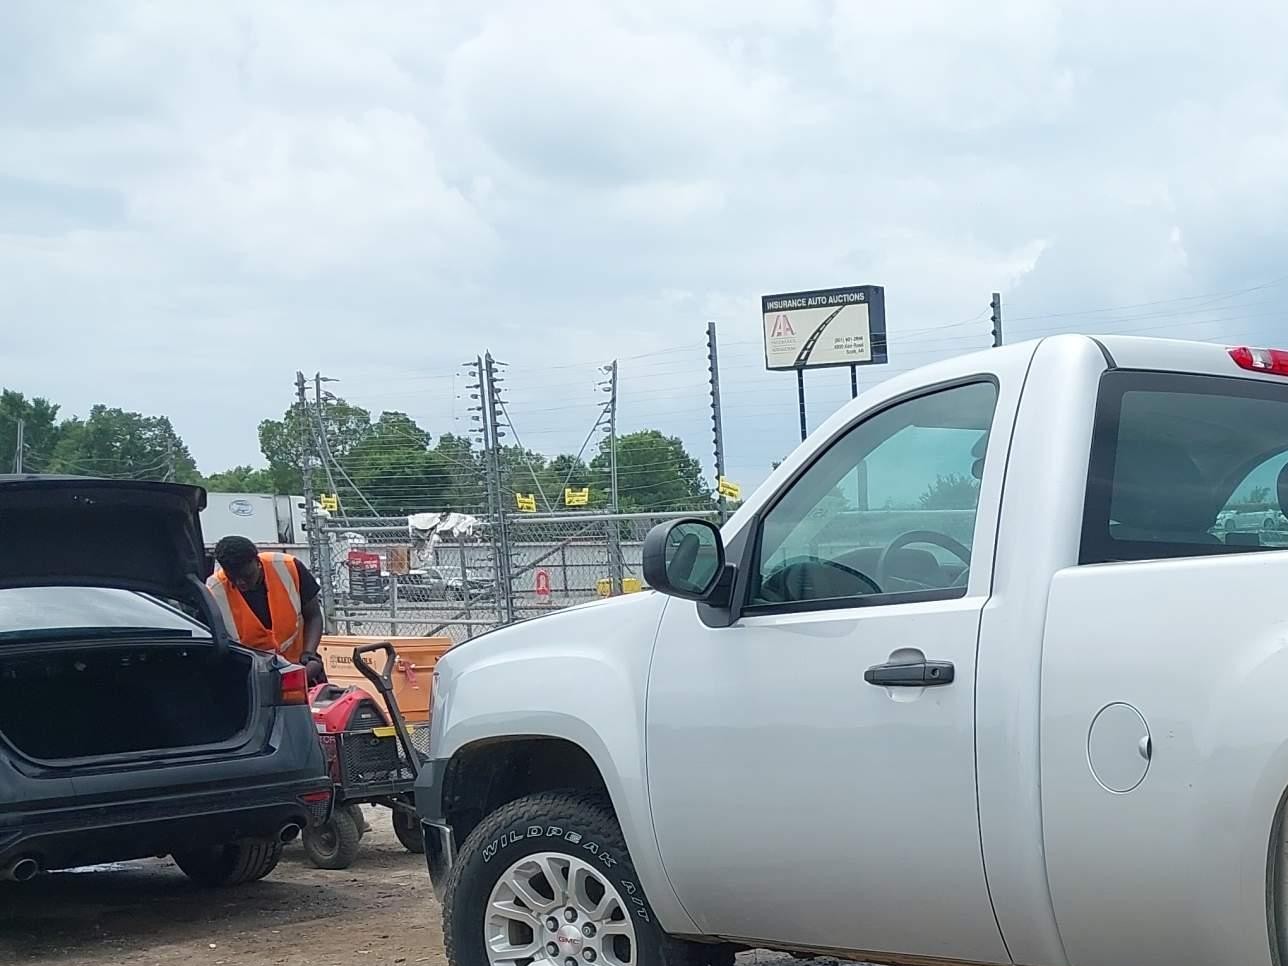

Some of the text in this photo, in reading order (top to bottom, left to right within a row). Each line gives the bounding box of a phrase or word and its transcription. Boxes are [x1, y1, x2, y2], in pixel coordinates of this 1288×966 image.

[767, 292, 865, 311] INSURANCE AUTO AUCTIONS
[482, 825, 618, 868] WILDPEAK
[558, 936, 580, 946] GMC
